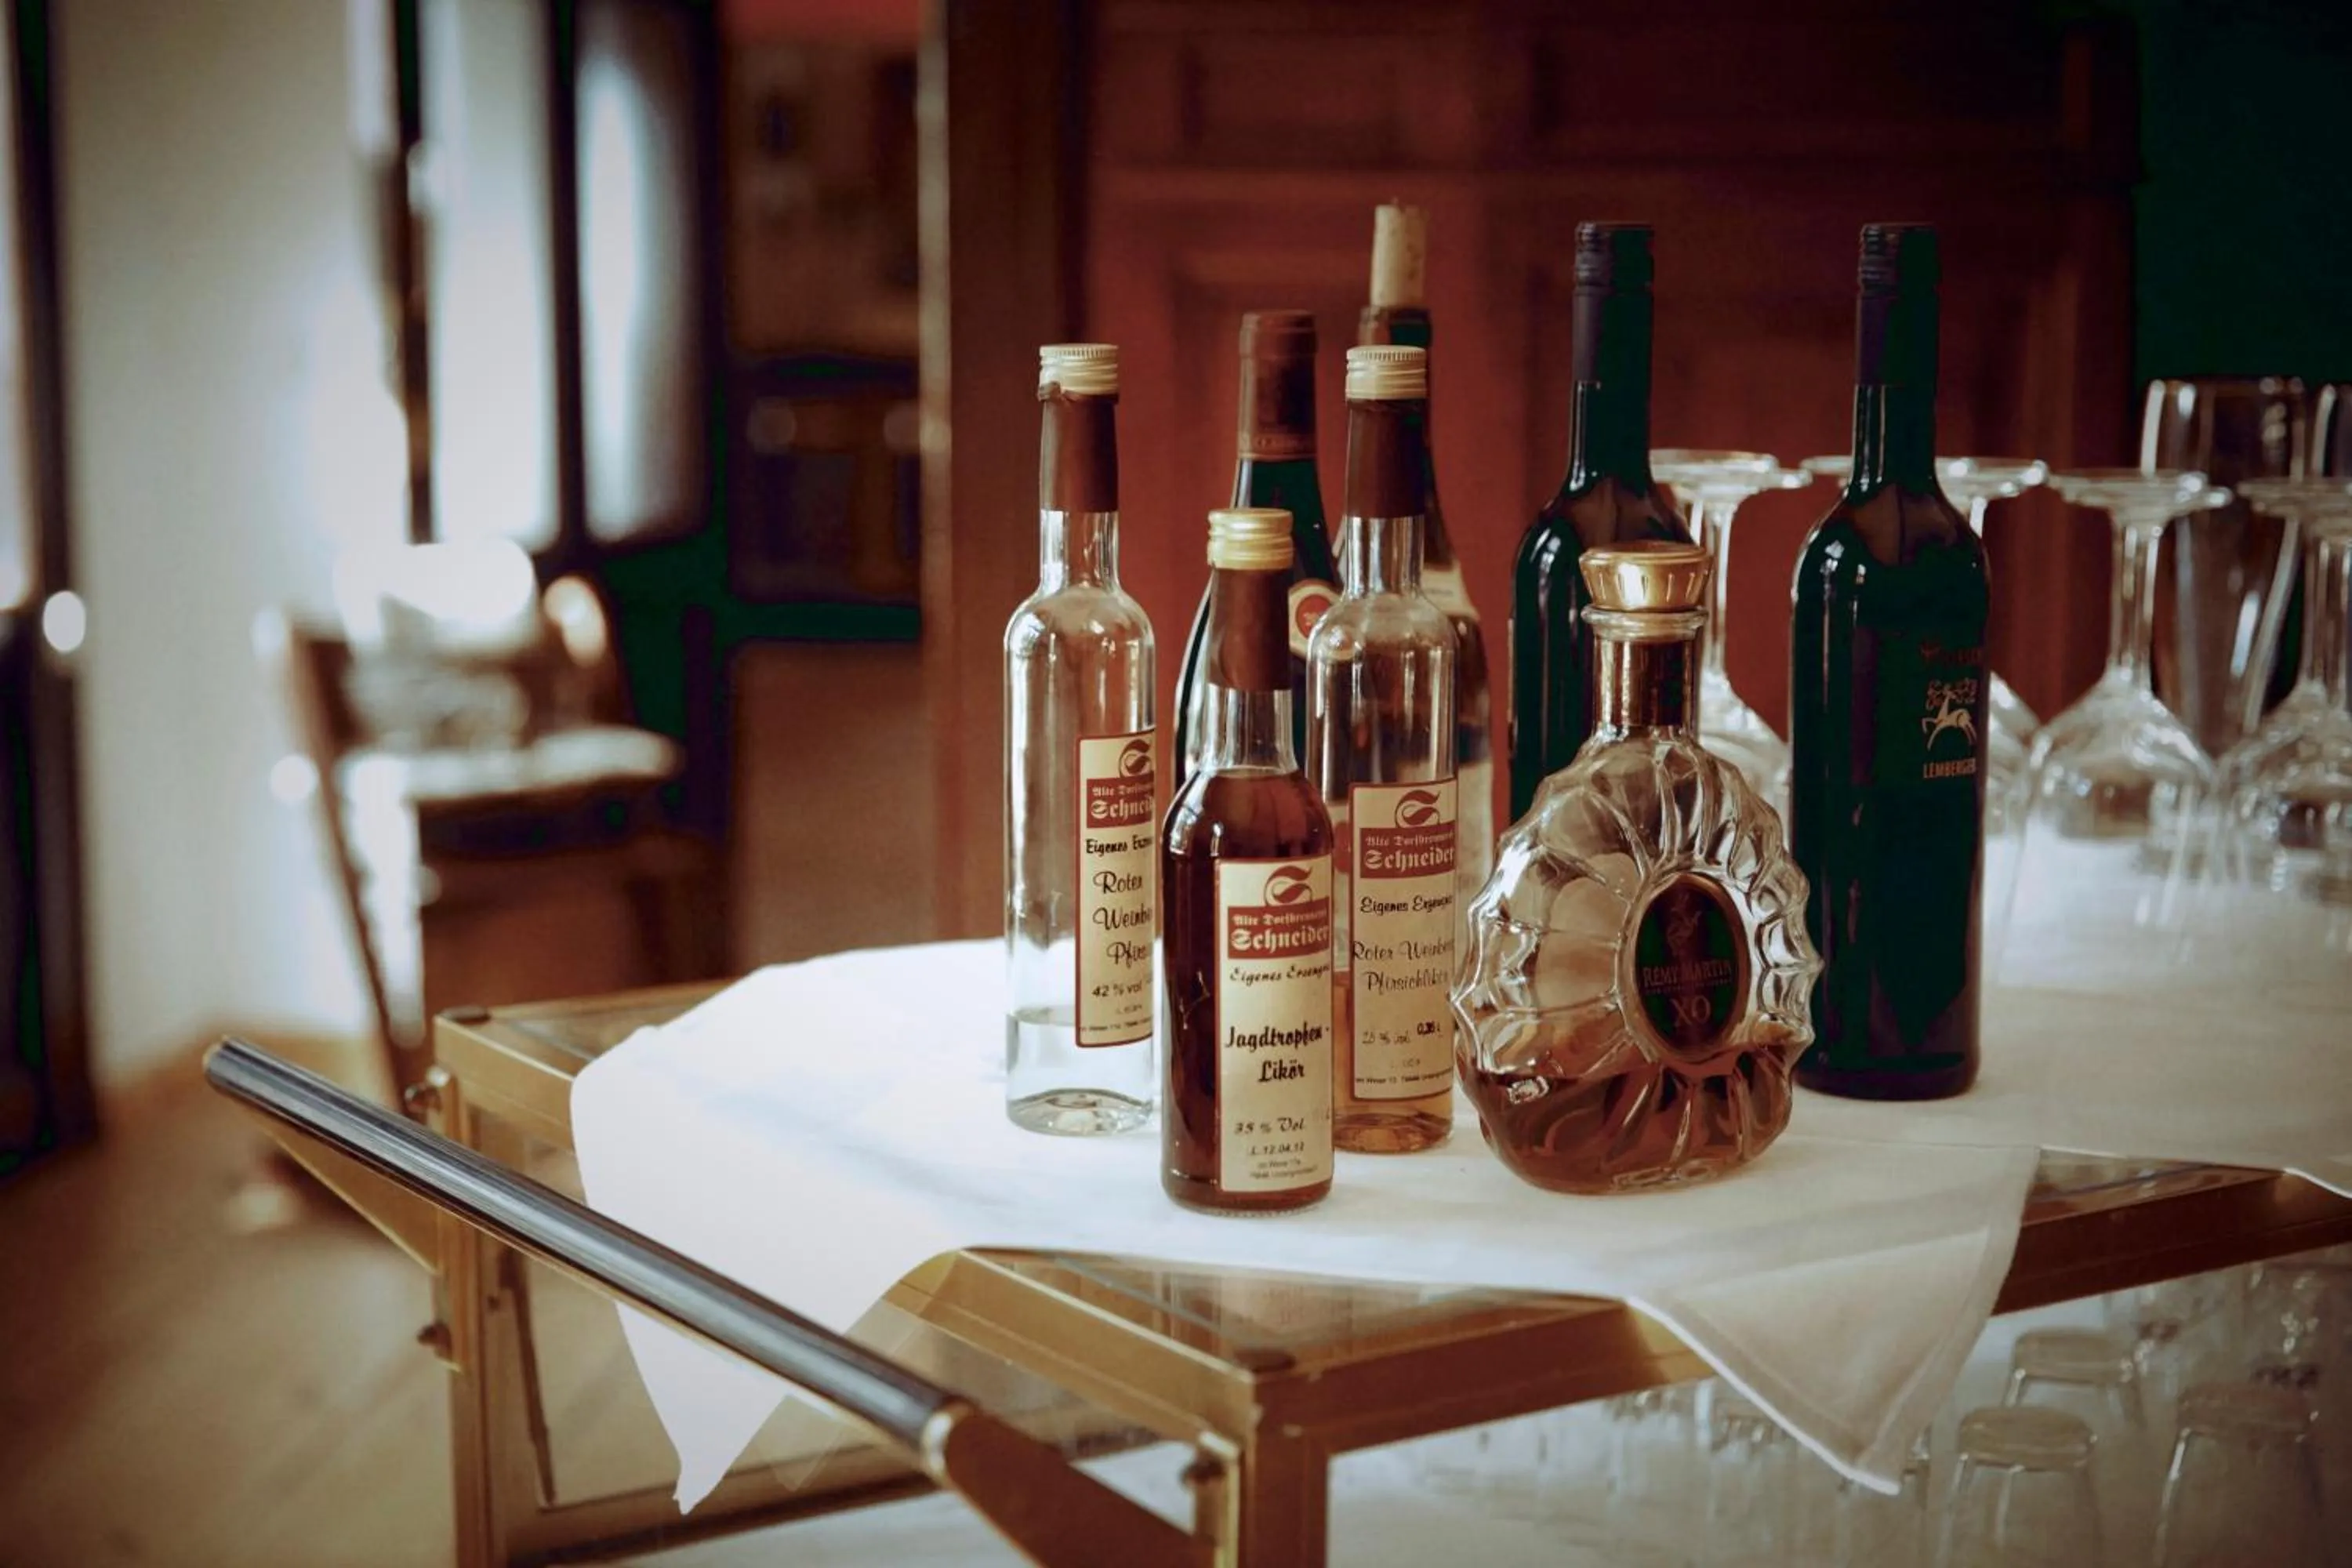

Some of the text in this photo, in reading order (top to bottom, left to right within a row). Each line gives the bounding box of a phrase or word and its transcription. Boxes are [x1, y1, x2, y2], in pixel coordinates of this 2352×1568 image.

[1086, 837, 1127, 857] Eigenes
[1364, 847, 1454, 872] Schneider
[1360, 895, 1409, 916] Eigenes
[1230, 924, 1329, 954] Schneider
[1230, 966, 1282, 986] Eigenes
[1091, 985, 1109, 998] 42
[1669, 994, 1712, 1028] XO
[1258, 1058, 1305, 1083] Likör
